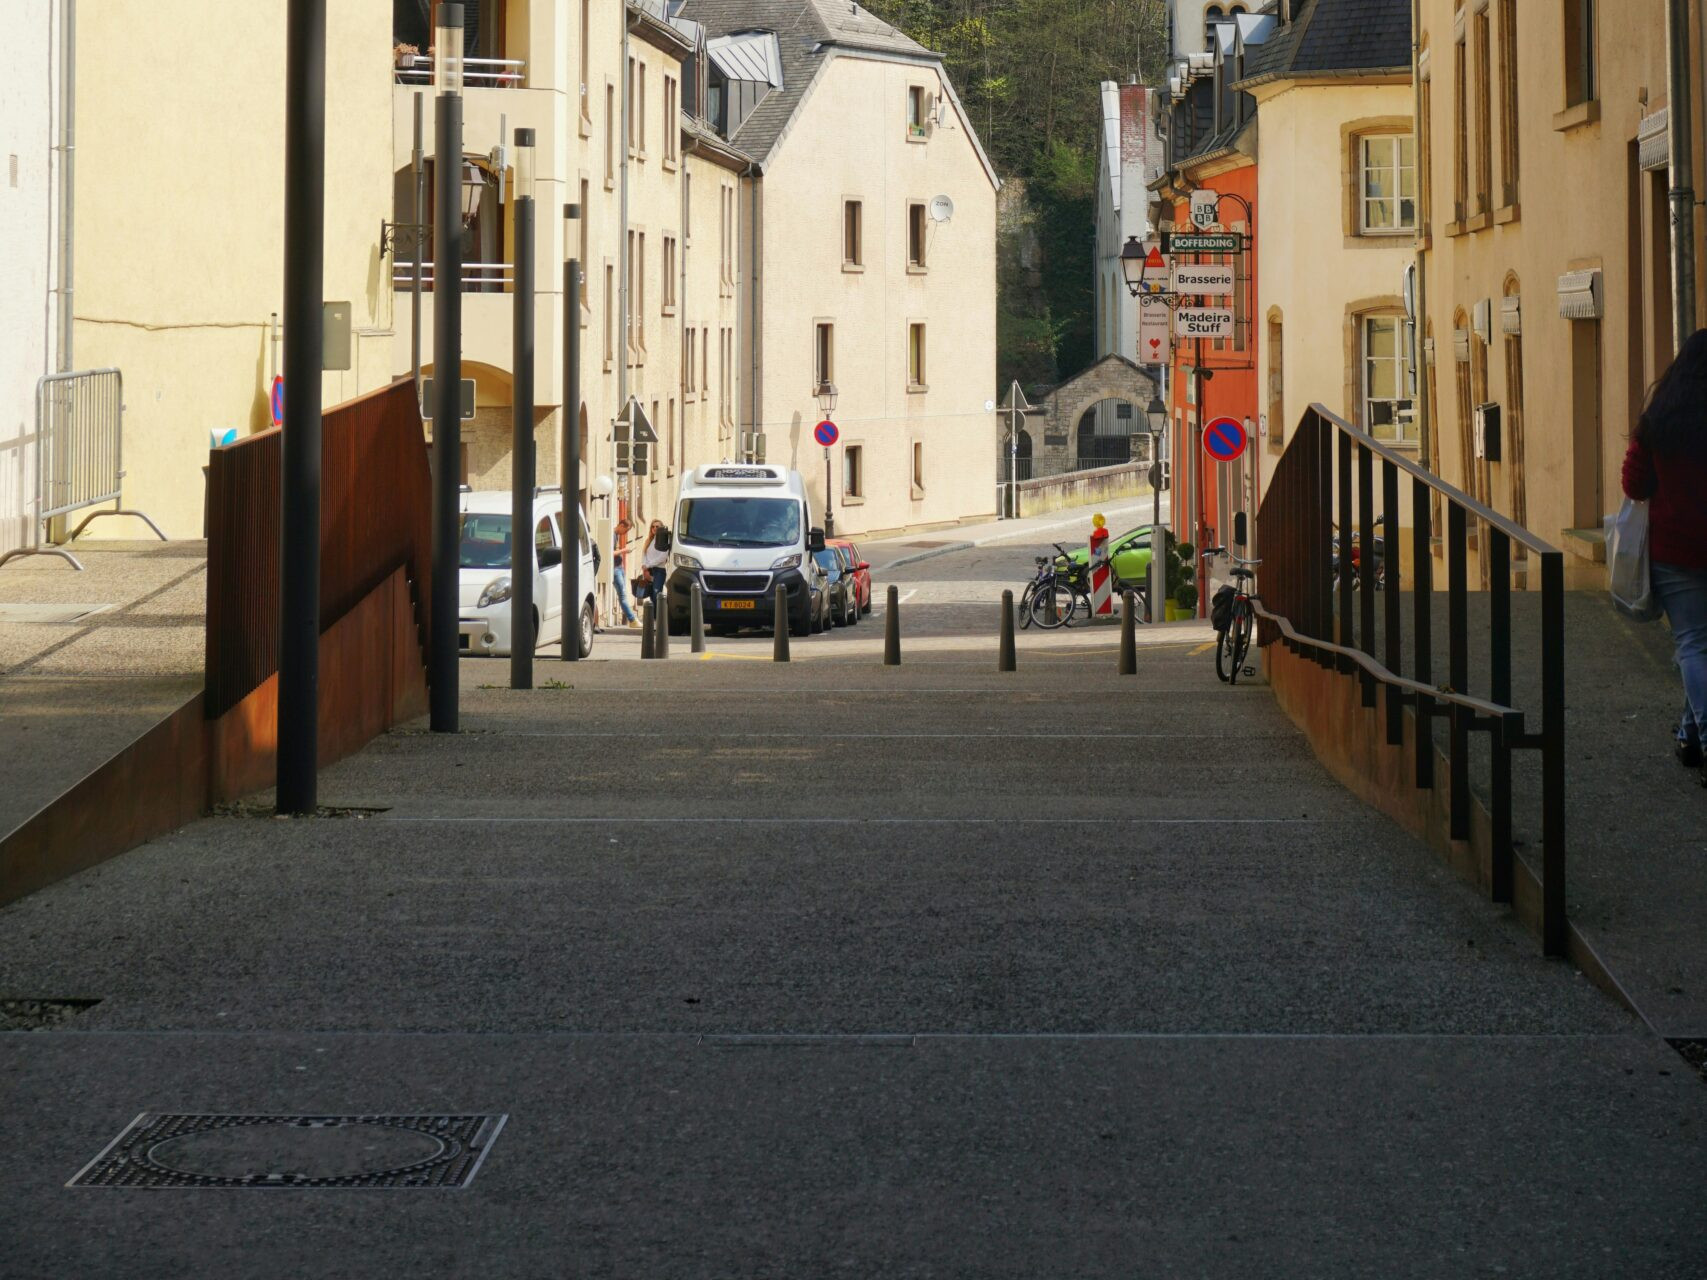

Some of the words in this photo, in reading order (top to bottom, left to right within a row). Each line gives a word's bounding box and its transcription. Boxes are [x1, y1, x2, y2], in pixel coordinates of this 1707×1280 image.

[1175, 239, 1233, 247] BOFFERDING
[1178, 274, 1231, 284] Brasserie
[1178, 312, 1231, 322] Madeira
[1187, 322, 1221, 332] Stuff
